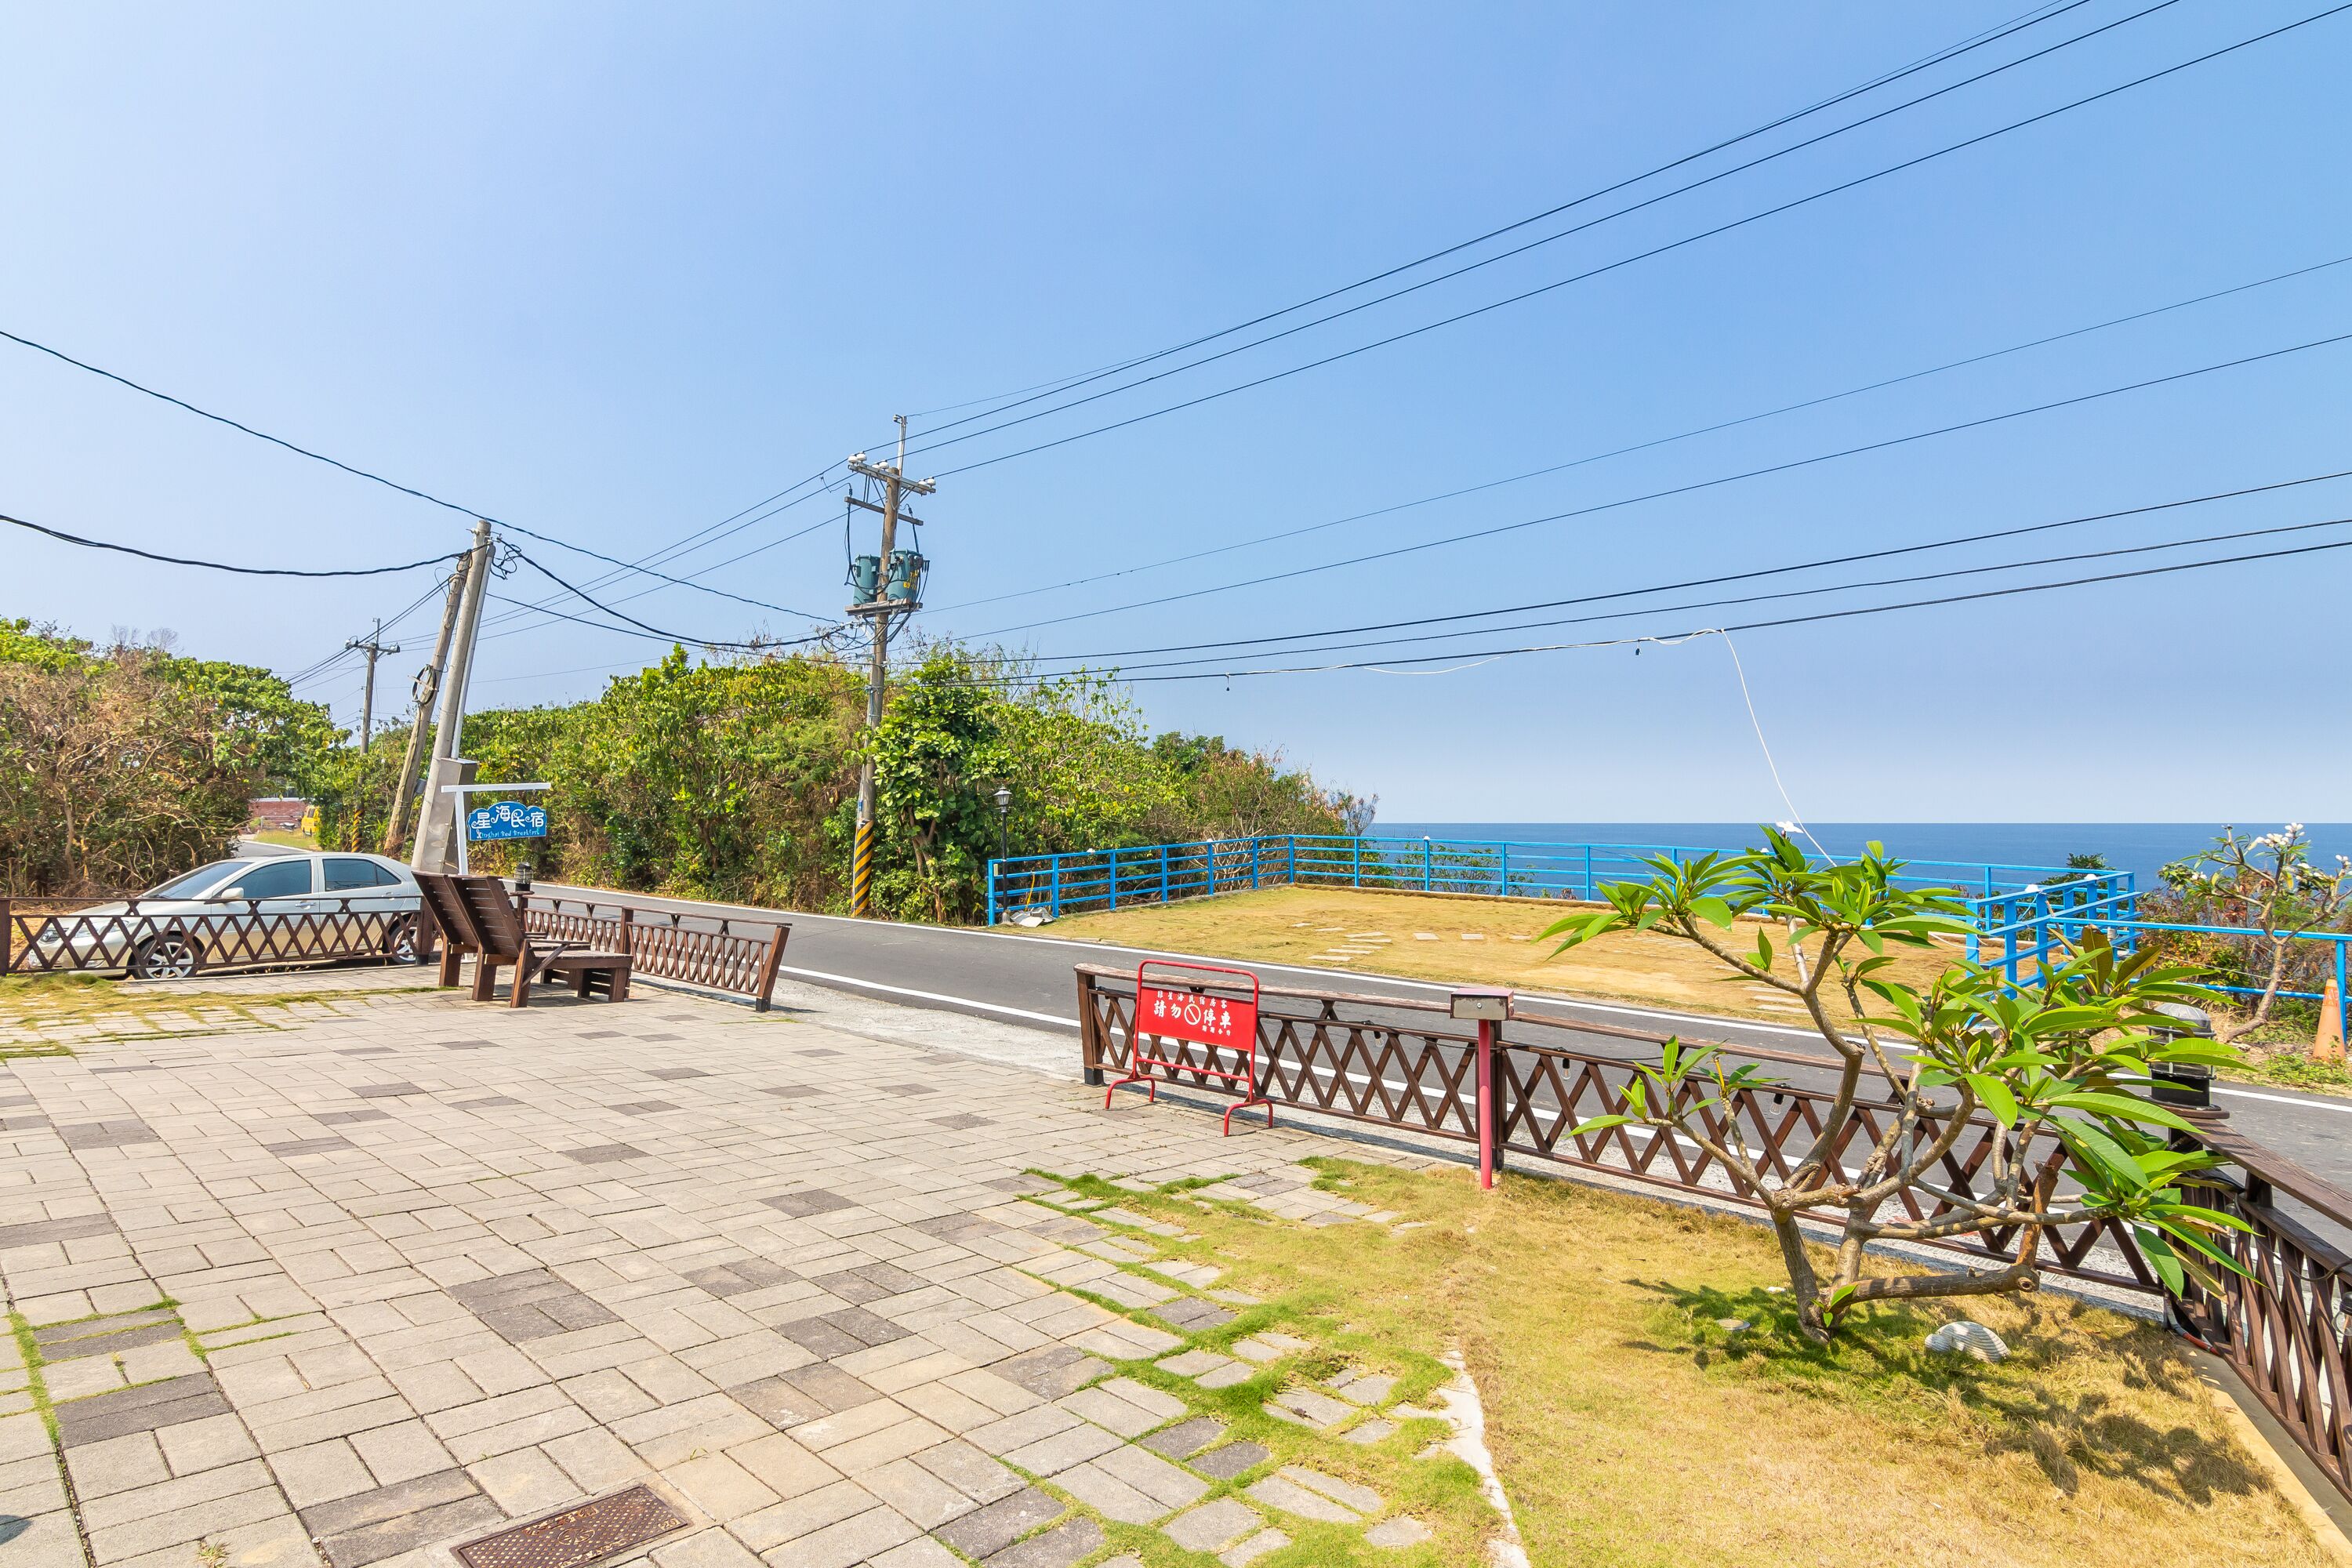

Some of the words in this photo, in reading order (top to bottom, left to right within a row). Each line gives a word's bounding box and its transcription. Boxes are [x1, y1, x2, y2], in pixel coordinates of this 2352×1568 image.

[471, 805, 544, 829] 星海民宿
[1157, 990, 1227, 1009] 非星海民宿房客
